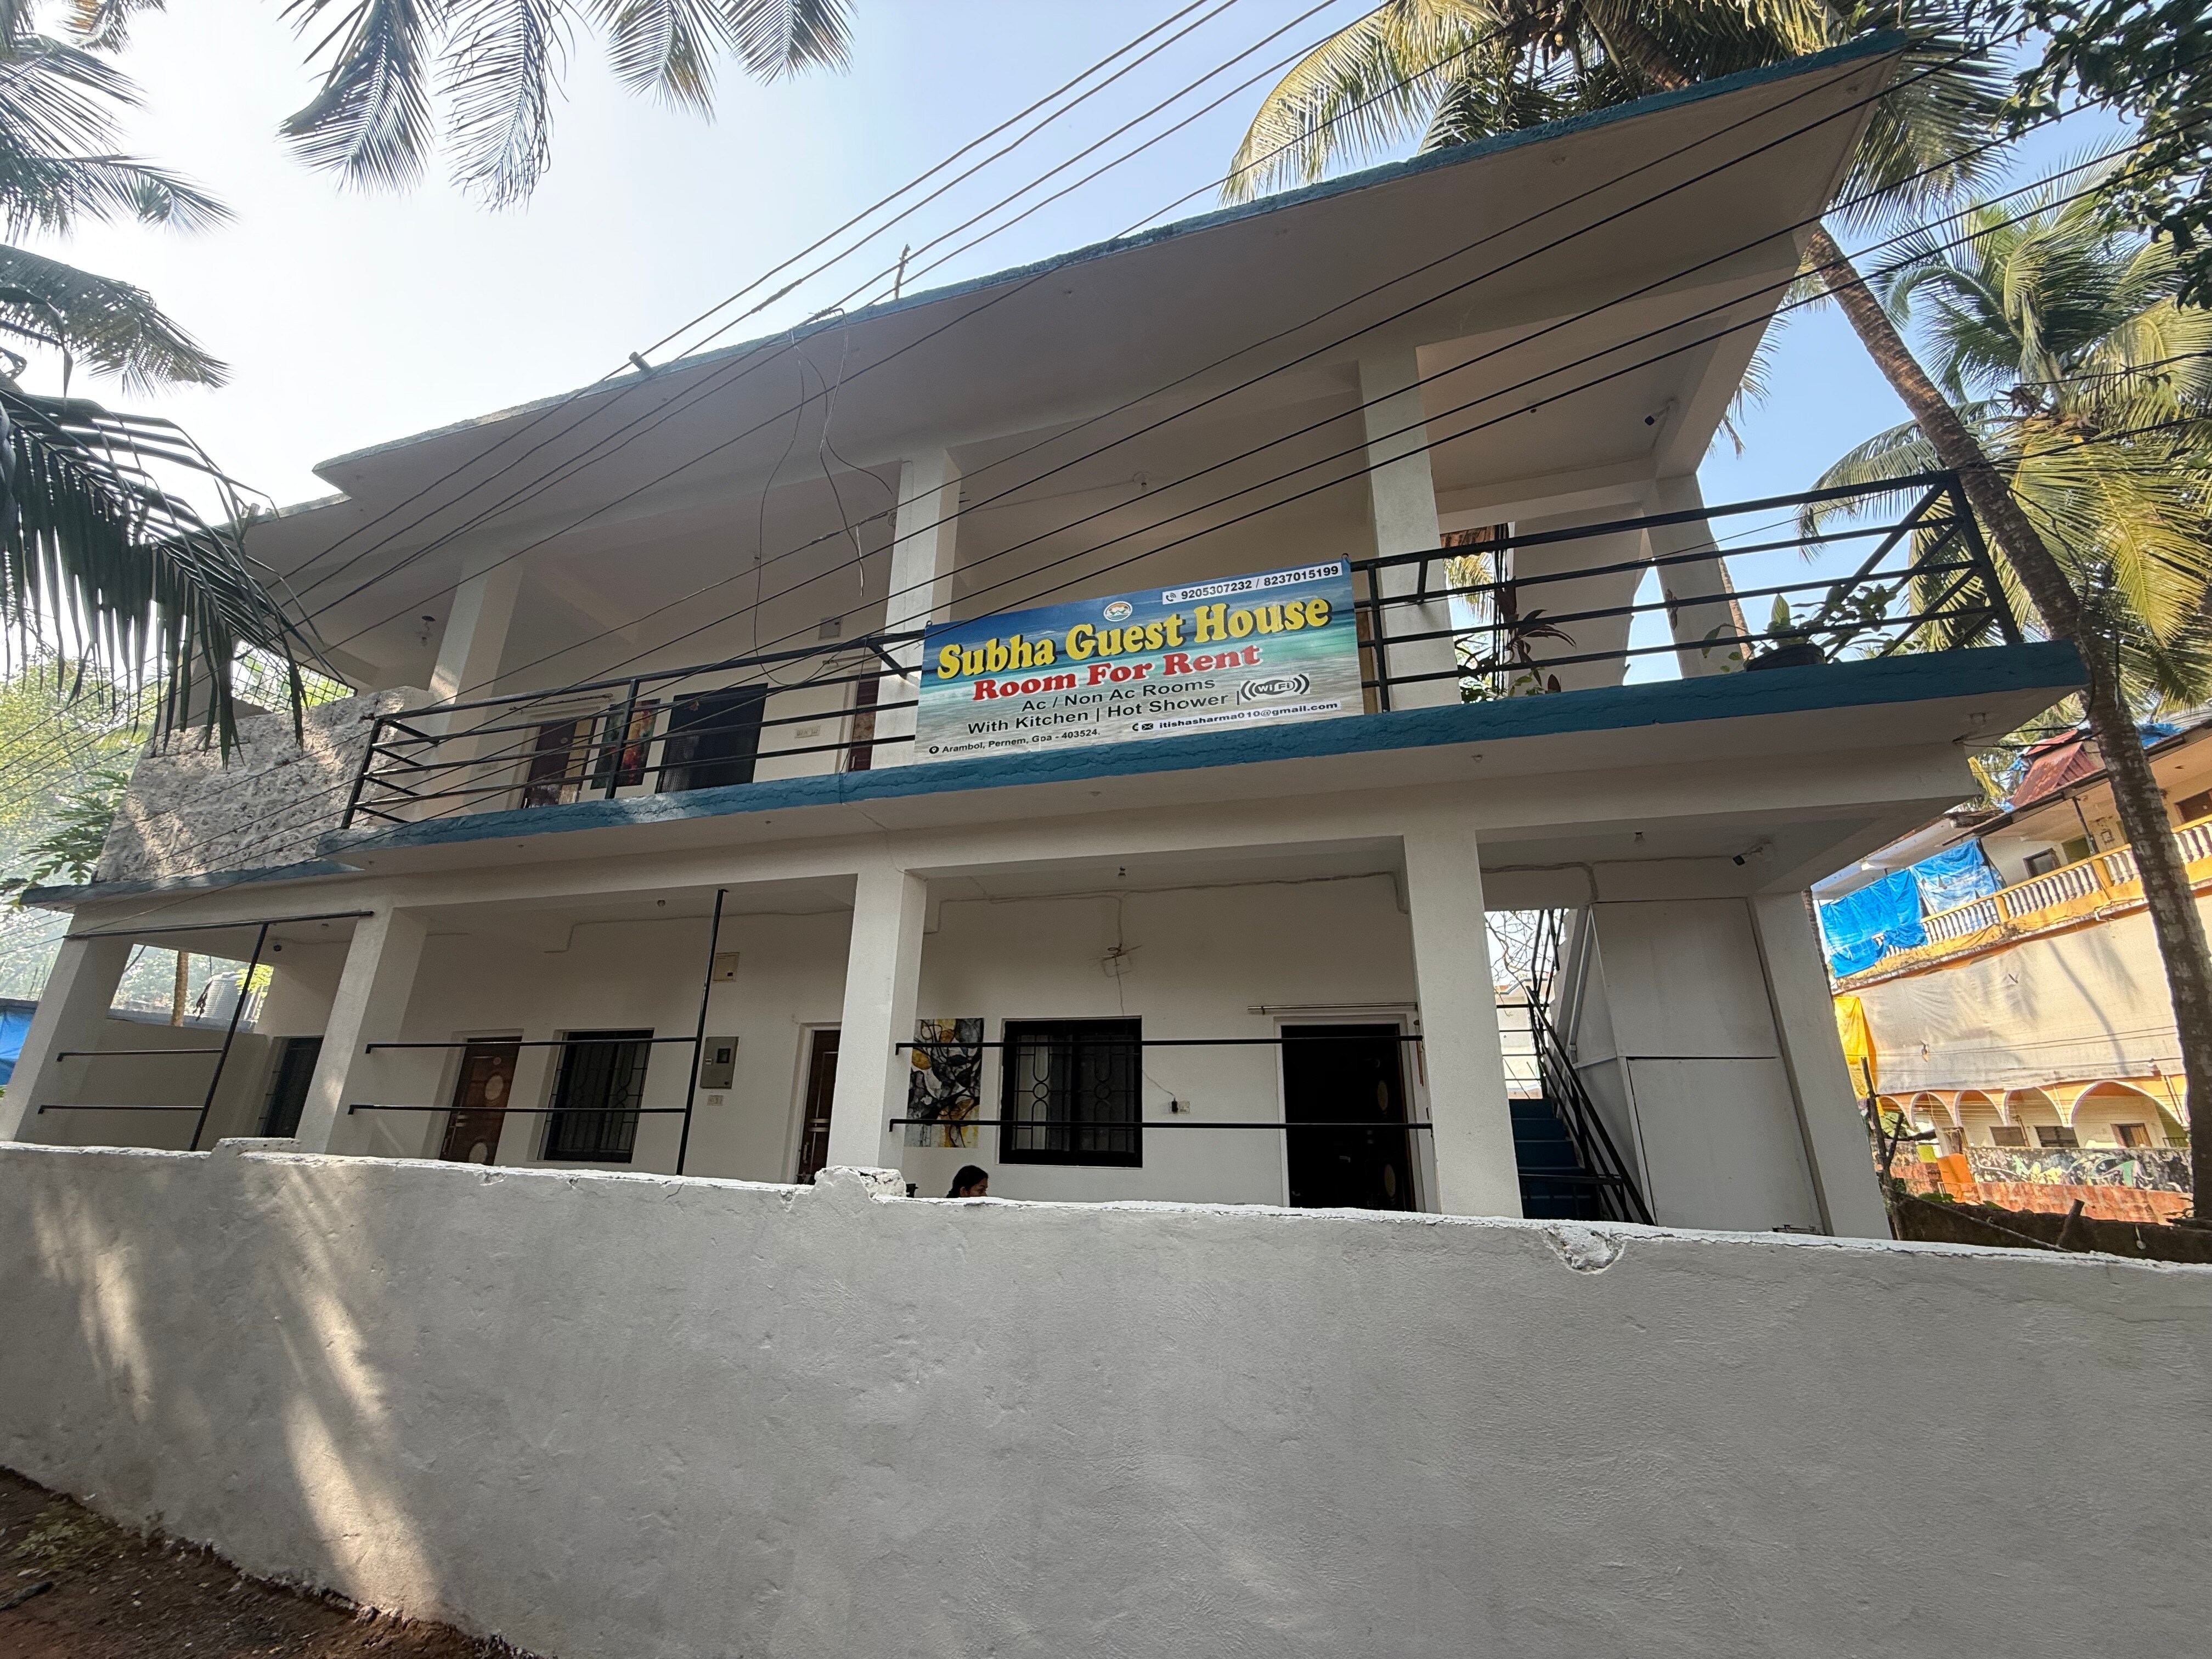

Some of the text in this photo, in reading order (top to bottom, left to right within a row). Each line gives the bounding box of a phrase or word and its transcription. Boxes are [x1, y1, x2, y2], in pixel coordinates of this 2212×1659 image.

[1181, 579, 1252, 600] 9205307232
[1263, 565, 1339, 587] 8237015199
[937, 598, 1332, 679] Subha Guest House
[972, 644, 1262, 702] Room For Rent
[968, 720, 1009, 735] With
[1015, 712, 1088, 730] Kitchen
[1107, 703, 1143, 718] Hot
[1149, 693, 1229, 713] Shower
[1021, 679, 1216, 713] Ac / Non Ac Rooms
[941, 742, 985, 753] Arambol,
[988, 737, 1029, 748] Pernem,
